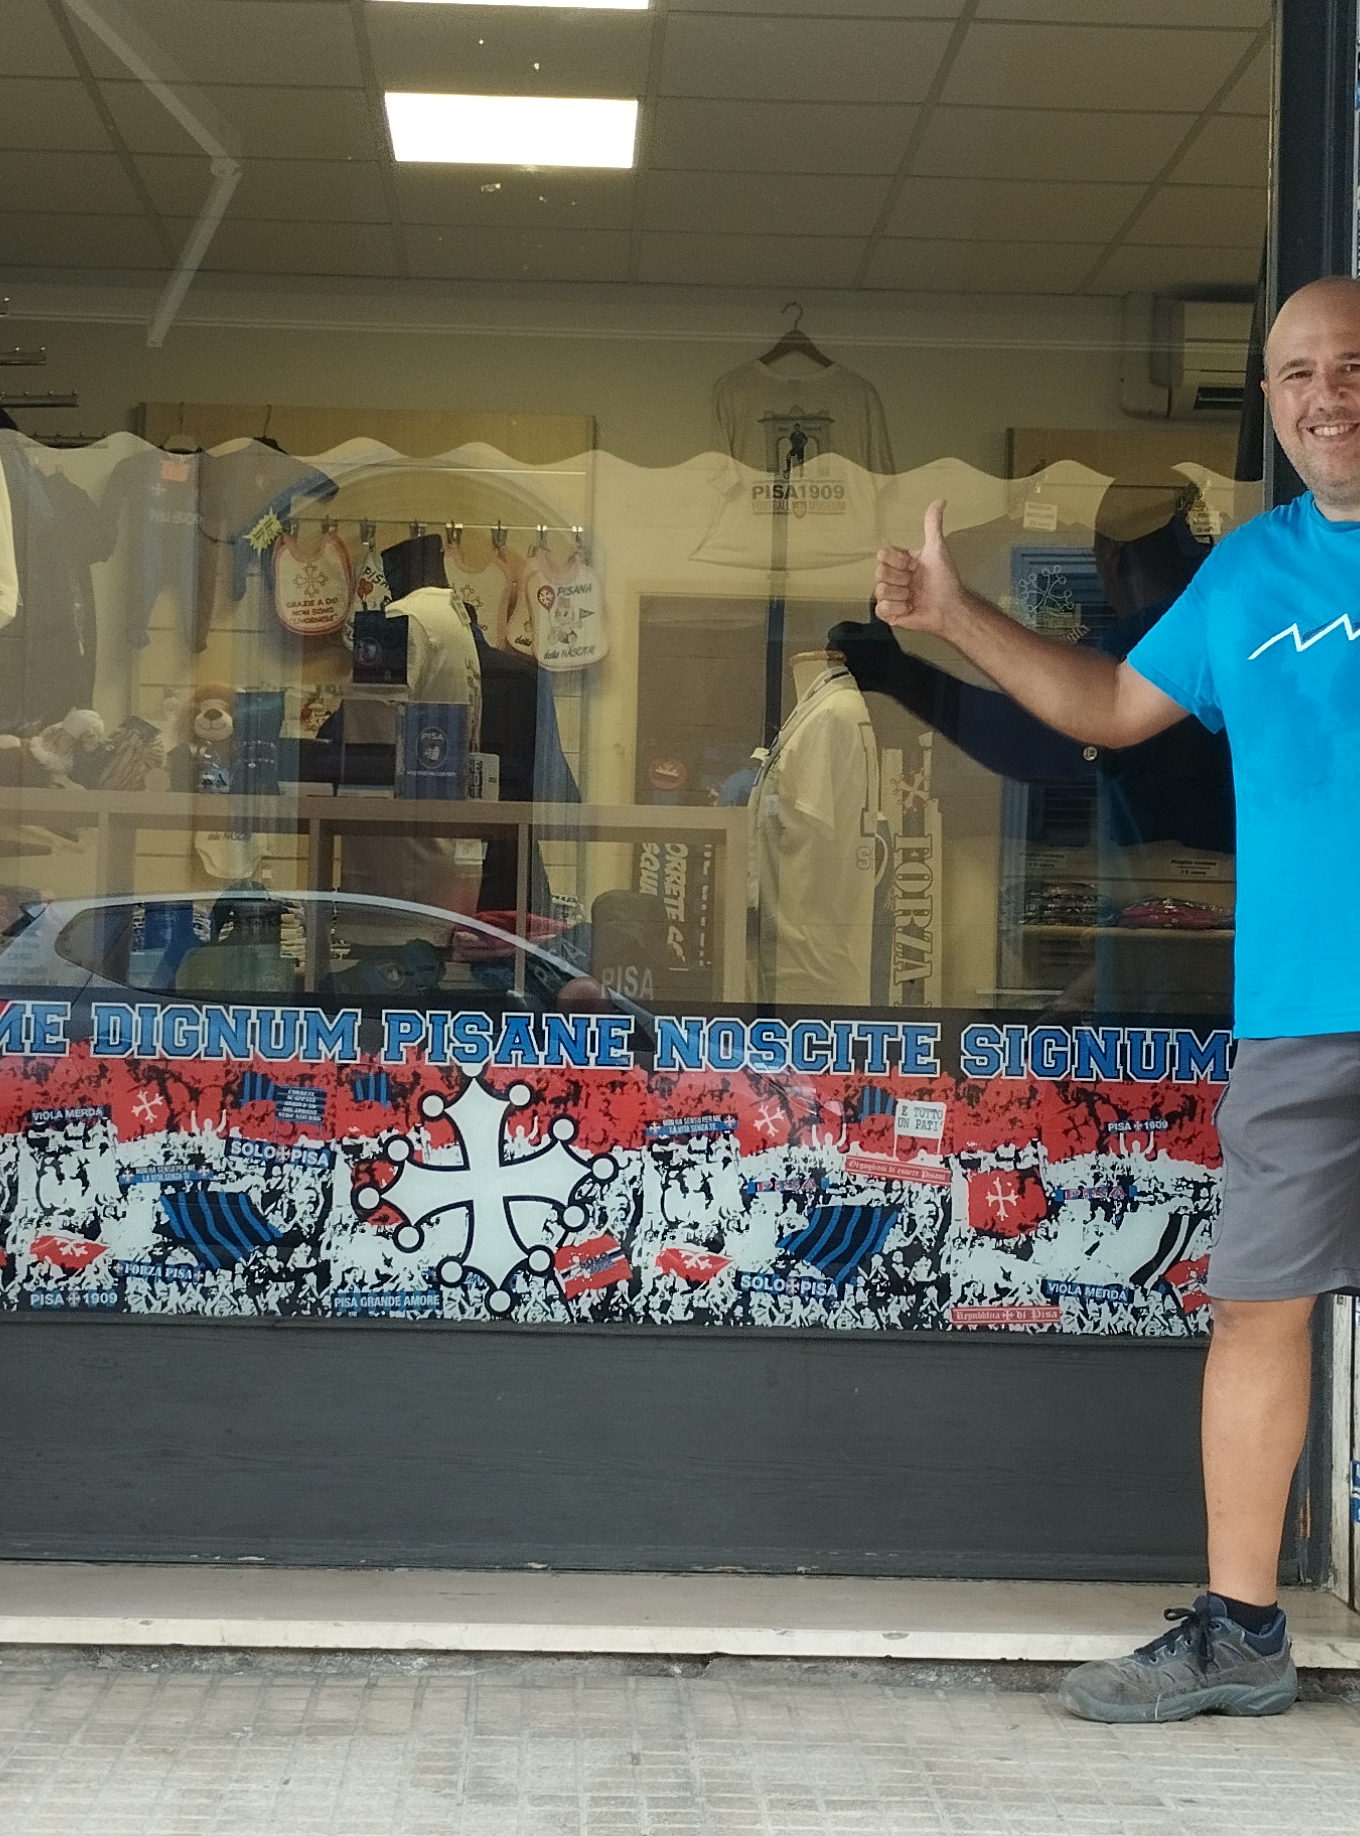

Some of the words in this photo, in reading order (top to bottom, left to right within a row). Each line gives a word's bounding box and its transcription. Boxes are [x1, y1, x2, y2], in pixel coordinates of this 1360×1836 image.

[893, 833, 933, 986] FORZA
[601, 966, 655, 1001] PISA
[90, 1003, 363, 1062] DIGNUM
[382, 1008, 634, 1069] PISANE
[655, 1015, 942, 1077] NOSCITE
[959, 1023, 1235, 1084] SIGNUM
[32, 1109, 64, 1122] VIOLA
[65, 1106, 103, 1119] MERDA
[914, 1107, 943, 1120] TUTTO
[897, 1117, 910, 1129] UN
[1108, 1121, 1132, 1132] PISA
[1143, 1119, 1169, 1130] 1909
[230, 1139, 276, 1159] SOLO
[291, 1149, 330, 1168] PISA
[124, 1263, 162, 1277] FORZA
[165, 1267, 193, 1280] PISA
[740, 1275, 786, 1292] SOLO
[800, 1283, 838, 1298] PISA
[1046, 1281, 1083, 1297] VIOLA
[1084, 1287, 1128, 1301] MERDA
[30, 1293, 65, 1306] PISA
[83, 1291, 118, 1305] 1909
[334, 1297, 359, 1308] PISA
[360, 1295, 402, 1308] GRANDE
[402, 1294, 440, 1307] AMORE
[1016, 1309, 1027, 1320] di
[1032, 1307, 1058, 1322] Pisa
